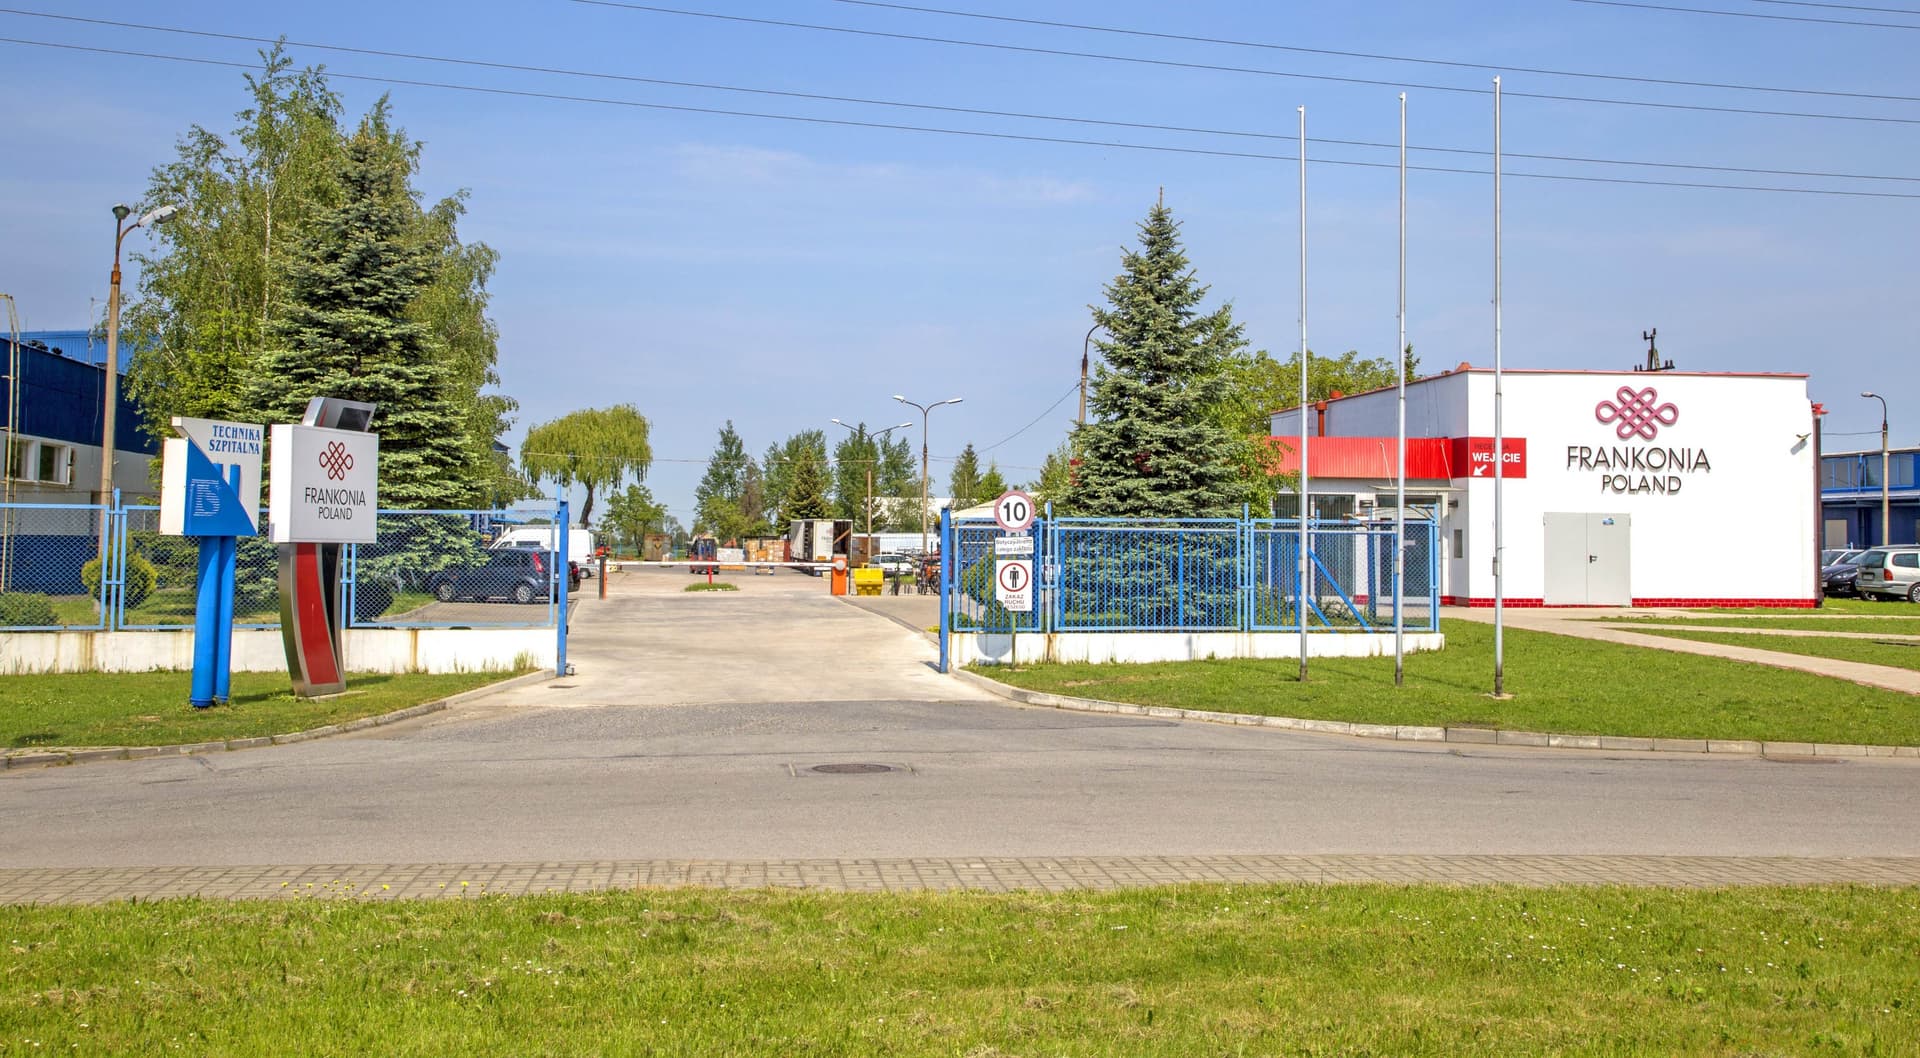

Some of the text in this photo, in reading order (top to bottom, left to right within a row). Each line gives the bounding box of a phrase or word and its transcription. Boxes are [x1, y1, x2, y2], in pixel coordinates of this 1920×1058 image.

[212, 424, 261, 441] TECHNIKA
[209, 439, 260, 455] SZPITALNA
[1472, 452, 1521, 463] WEJCIE
[1567, 446, 1711, 471] FRANKONIA
[1601, 474, 1682, 493] POLAND
[304, 487, 366, 506] FRANKONIA
[318, 506, 353, 520] POLAND
[1003, 502, 1026, 521] 10
